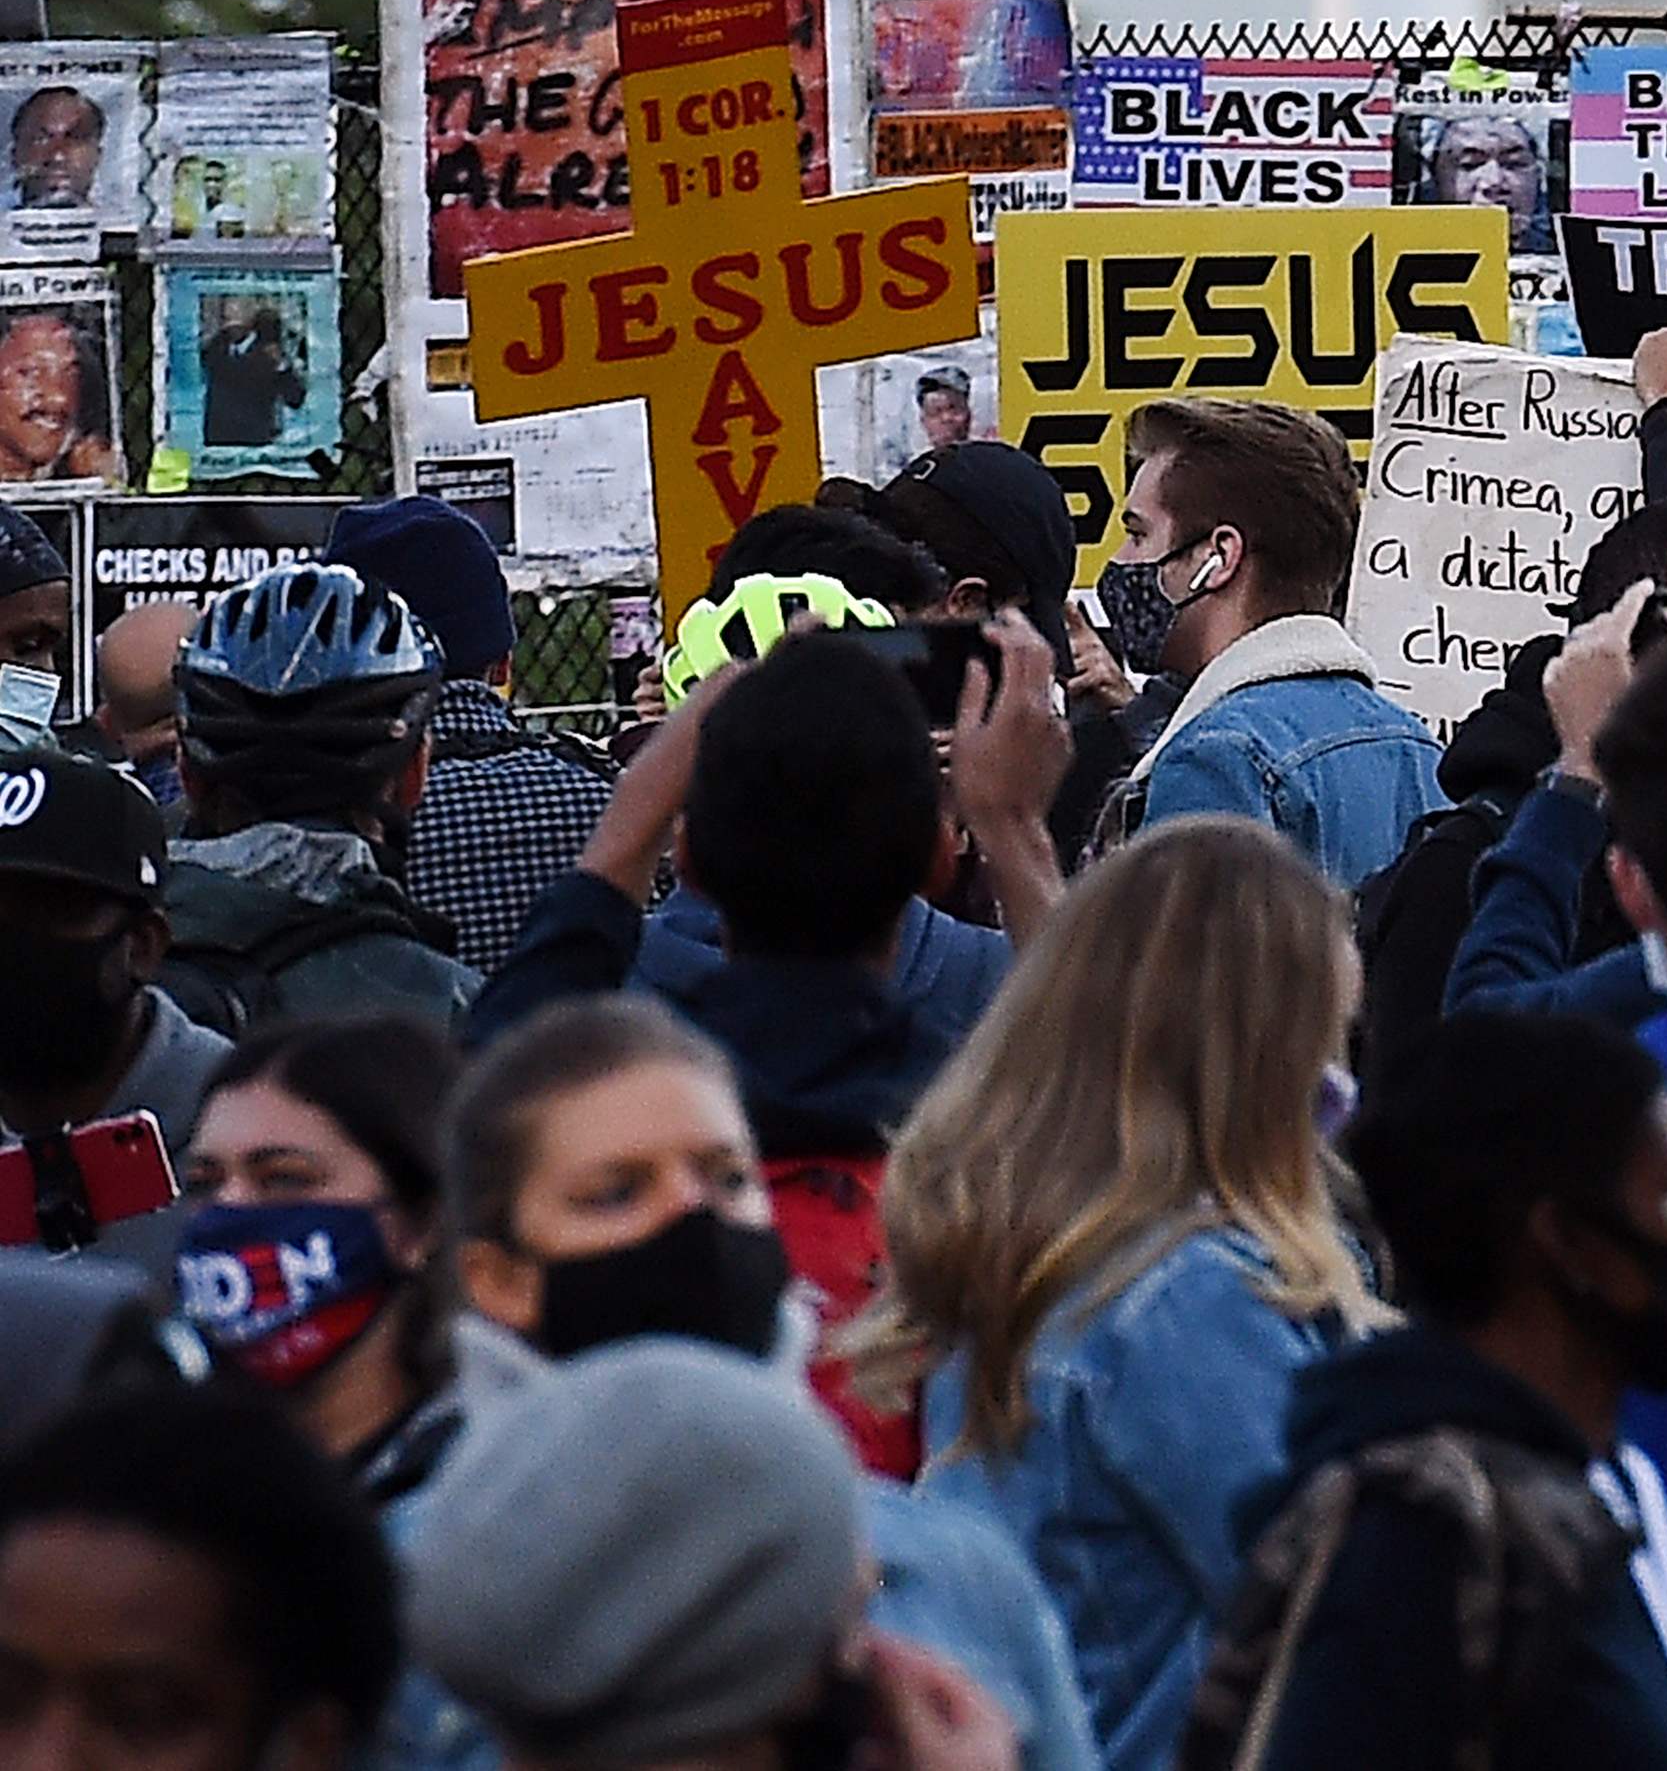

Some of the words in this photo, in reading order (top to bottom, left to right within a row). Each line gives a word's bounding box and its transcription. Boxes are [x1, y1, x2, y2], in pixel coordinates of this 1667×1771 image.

[426, 72, 575, 136] THE
[641, 99, 662, 143] 1
[676, 81, 786, 136] COR.
[1110, 89, 1370, 139] BLACK
[428, 144, 631, 213] ALRE
[659, 149, 761, 207] 1:18
[1144, 158, 1344, 203] LIVES
[503, 217, 950, 376] JESUS
[1022, 232, 1481, 392] JESUS
[1389, 360, 1504, 429] After
[1380, 440, 1574, 532] Crimea,
[1590, 486, 1649, 520] an
[96, 548, 206, 584] CHECKS
[211, 550, 269, 582] AND
[1369, 539, 1408, 578] a
[1441, 530, 1582, 595] dictato
